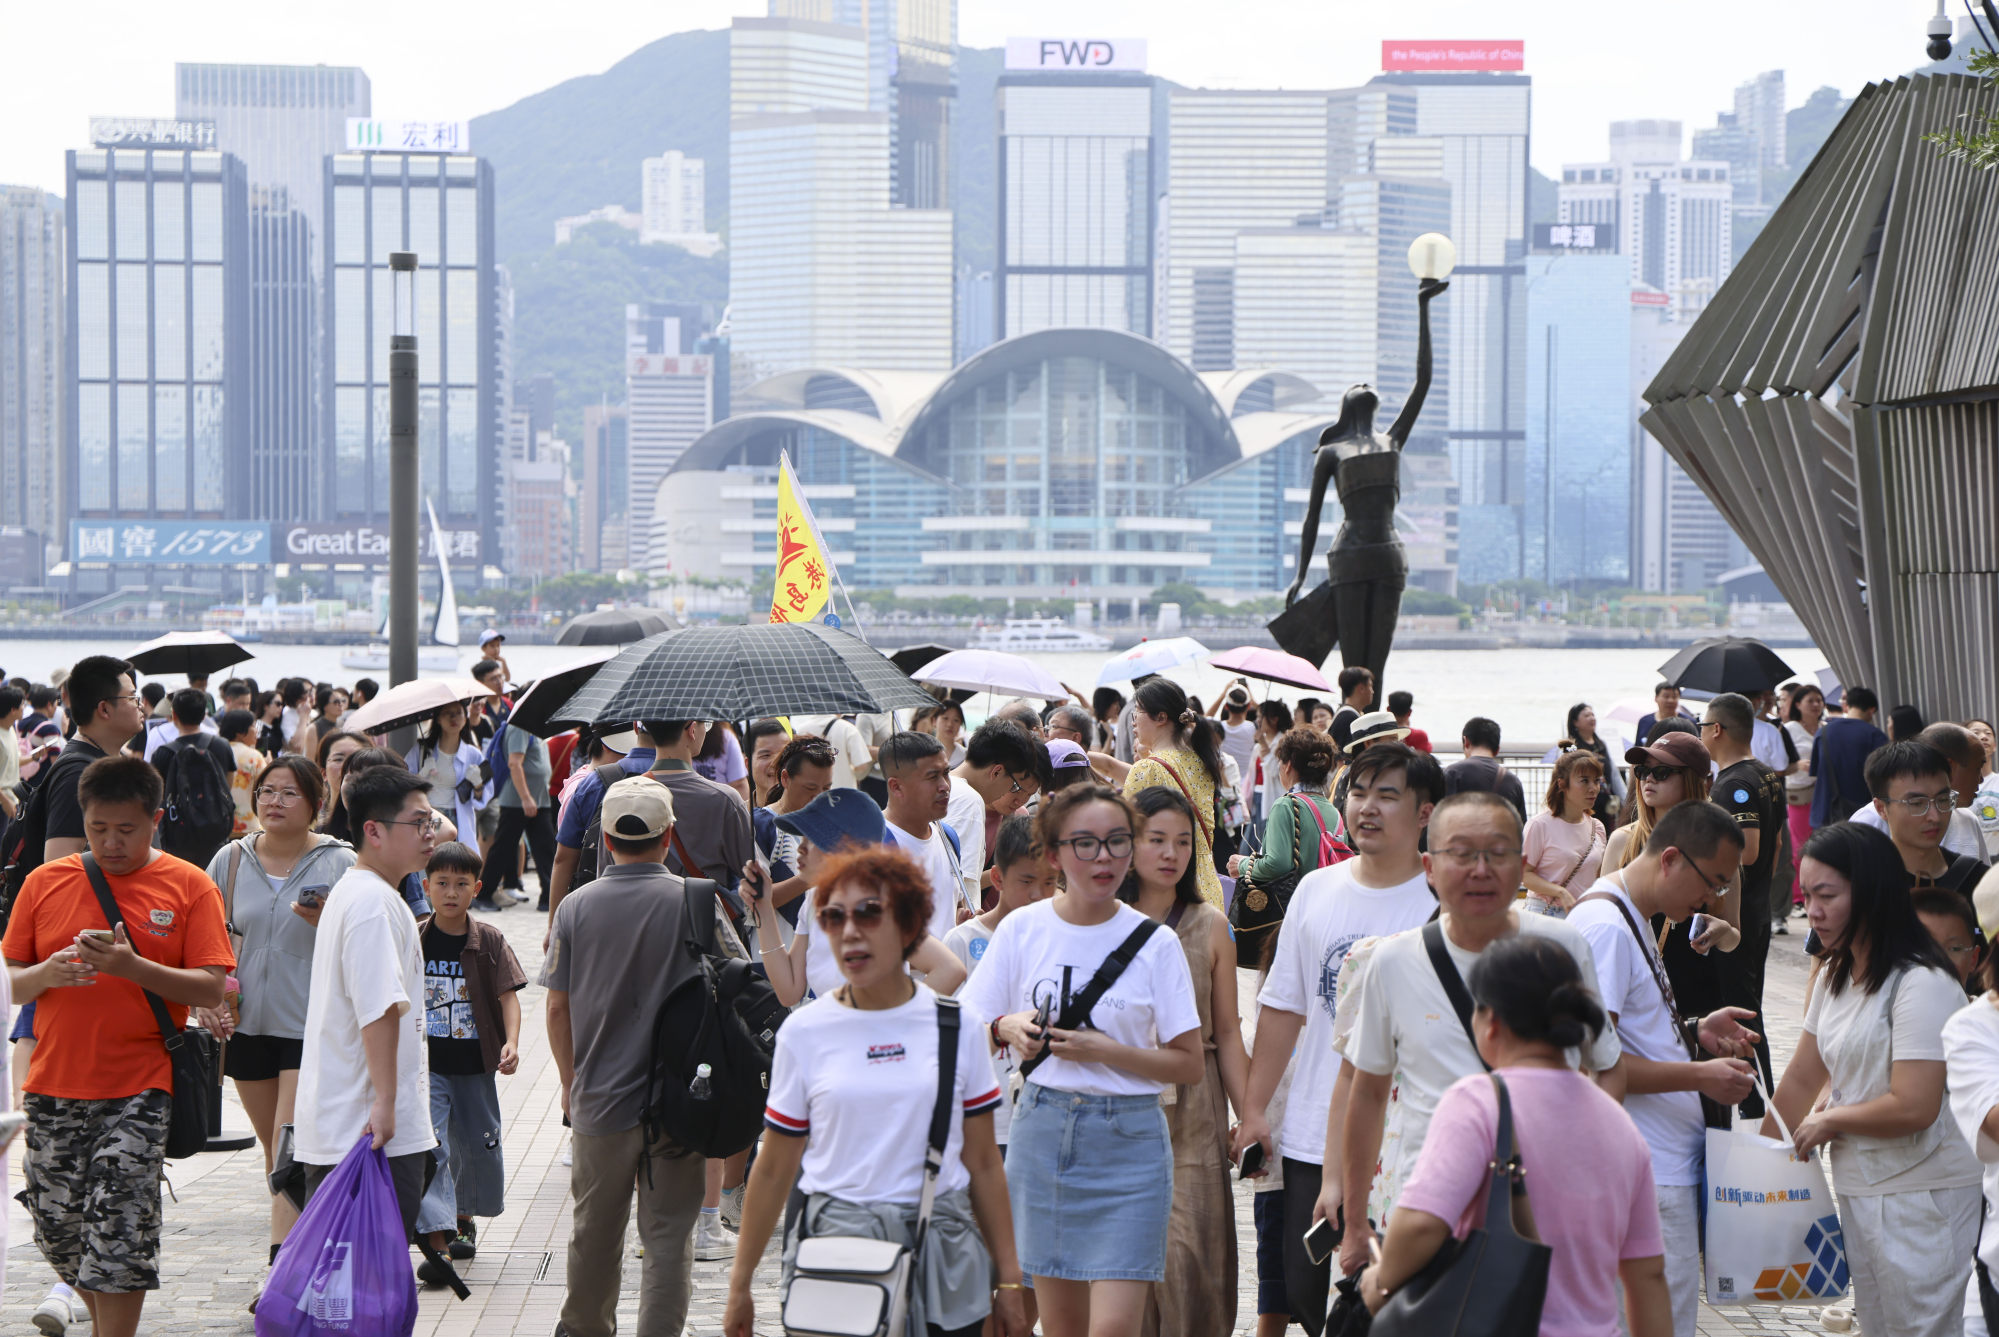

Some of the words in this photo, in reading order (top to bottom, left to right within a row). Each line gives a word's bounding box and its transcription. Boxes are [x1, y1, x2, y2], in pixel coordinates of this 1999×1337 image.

[1040, 41, 1114, 66] FWD
[1391, 49, 1408, 60] the
[1409, 49, 1447, 63] People's
[1448, 49, 1487, 62] Republic
[1488, 49, 1500, 60] of
[402, 121, 459, 149] 宏利
[1550, 225, 1596, 248] 啤酒
[79, 525, 157, 558] 國窖
[160, 529, 264, 556] 1573
[287, 527, 355, 555] Great
[424, 959, 463, 976] ART
[1715, 1186, 1811, 1207] 创新驱动未来制造
